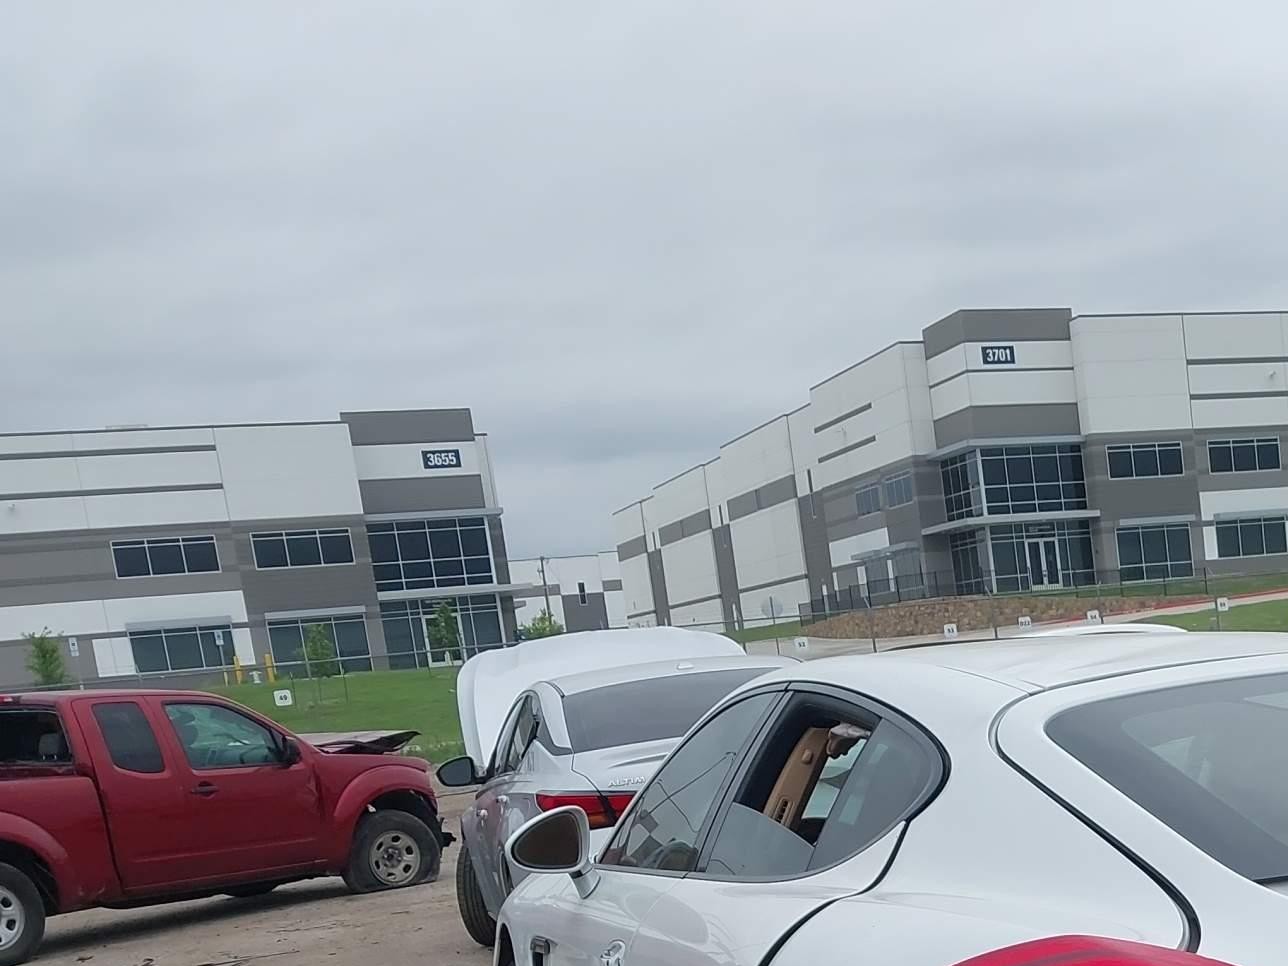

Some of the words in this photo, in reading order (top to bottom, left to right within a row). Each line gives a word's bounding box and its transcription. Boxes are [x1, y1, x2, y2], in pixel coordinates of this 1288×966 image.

[986, 348, 1011, 362] 3701
[426, 453, 457, 466] 3655
[608, 776, 646, 787] ALTIM
